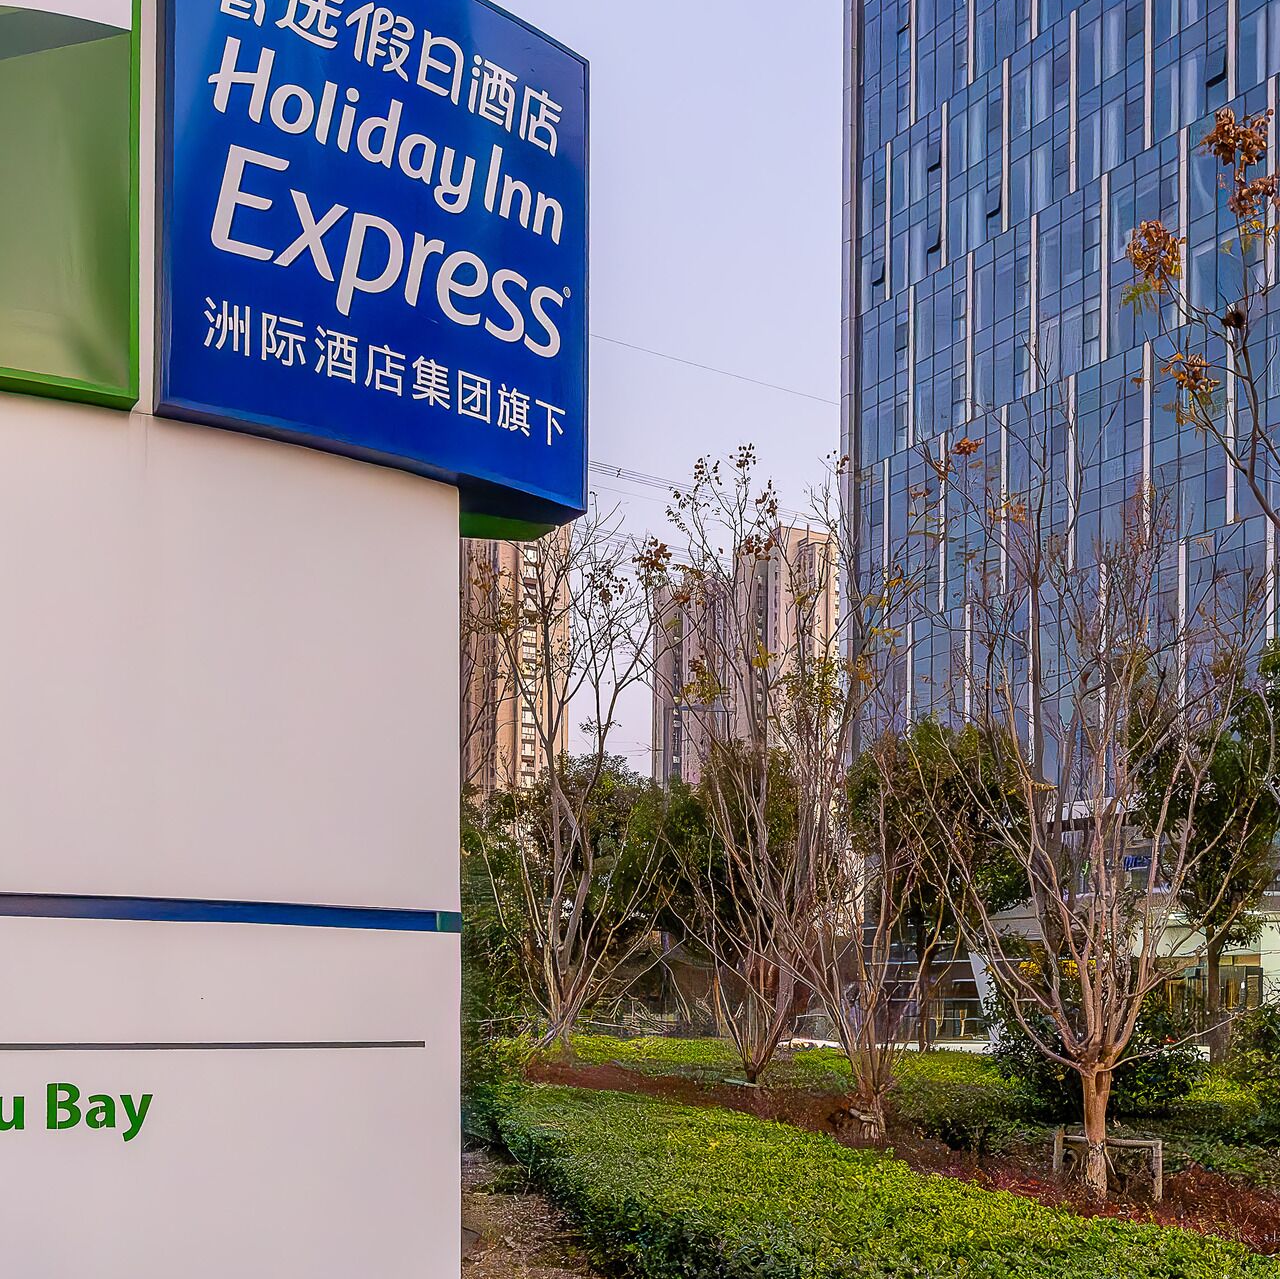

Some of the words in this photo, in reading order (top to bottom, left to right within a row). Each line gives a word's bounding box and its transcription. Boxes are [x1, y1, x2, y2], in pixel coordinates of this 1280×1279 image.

[206, 35, 477, 215] Holiday
[483, 142, 565, 246] Inn
[209, 143, 566, 359] Express
[203, 296, 567, 447] 洲际酒店集团旗下
[44, 1082, 154, 1142] Bay
